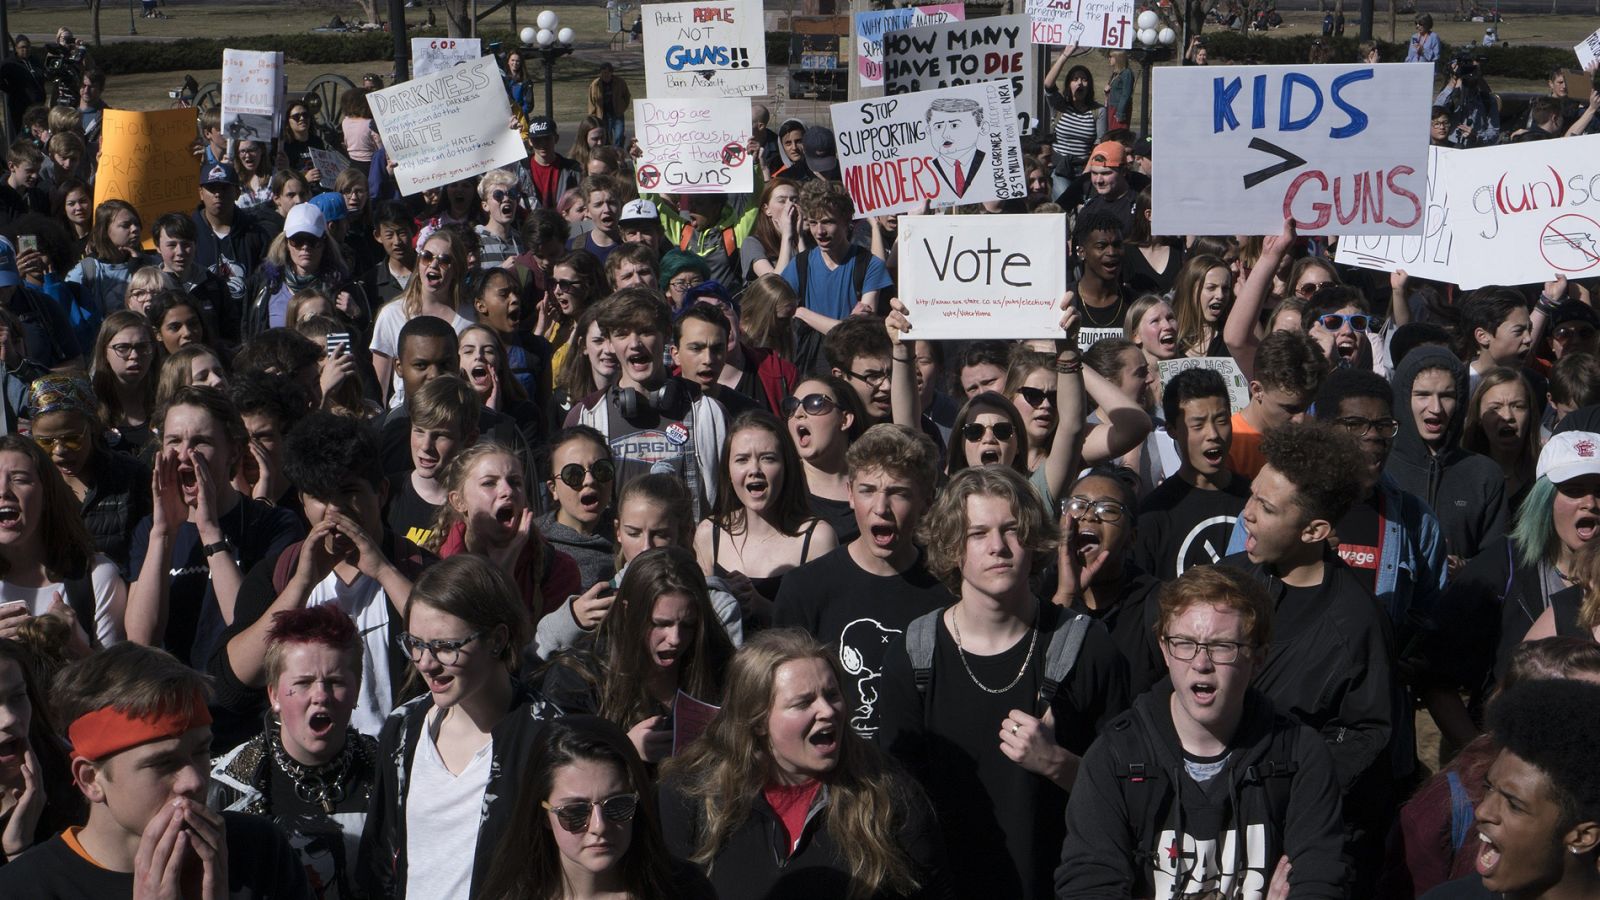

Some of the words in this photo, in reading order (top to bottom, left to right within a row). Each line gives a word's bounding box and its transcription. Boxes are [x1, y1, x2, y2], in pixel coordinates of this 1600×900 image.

[655, 11, 684, 26] Protect
[693, 7, 735, 24] PEOPLE
[862, 18, 881, 36] WHY
[678, 26, 715, 41] NOT
[884, 31, 937, 56] HOW
[947, 26, 1020, 50] MANY
[1031, 22, 1062, 43] KIDS
[885, 57, 941, 81] HAVE
[946, 54, 979, 75] TO
[984, 51, 1024, 75] DIE
[374, 64, 490, 116] DARKNESS
[667, 74, 687, 88] Ban
[998, 84, 1011, 104] NRA
[1213, 68, 1374, 139] KIDS
[642, 102, 686, 127] Drugs
[690, 109, 710, 119] are
[861, 99, 897, 124] STOP
[388, 122, 442, 151] HATE
[451, 134, 477, 147] HATE
[839, 121, 926, 156] SUPPORTING
[100, 151, 188, 176] PRAYERS
[648, 147, 682, 163] Safer
[872, 147, 900, 161] OUR
[664, 161, 732, 185] Guns
[844, 156, 940, 214] MURDERS
[1283, 165, 1422, 230] GUNS
[923, 236, 1032, 287] Vote
[1159, 359, 1200, 379] FEAR
[1205, 359, 1233, 374] HAS
